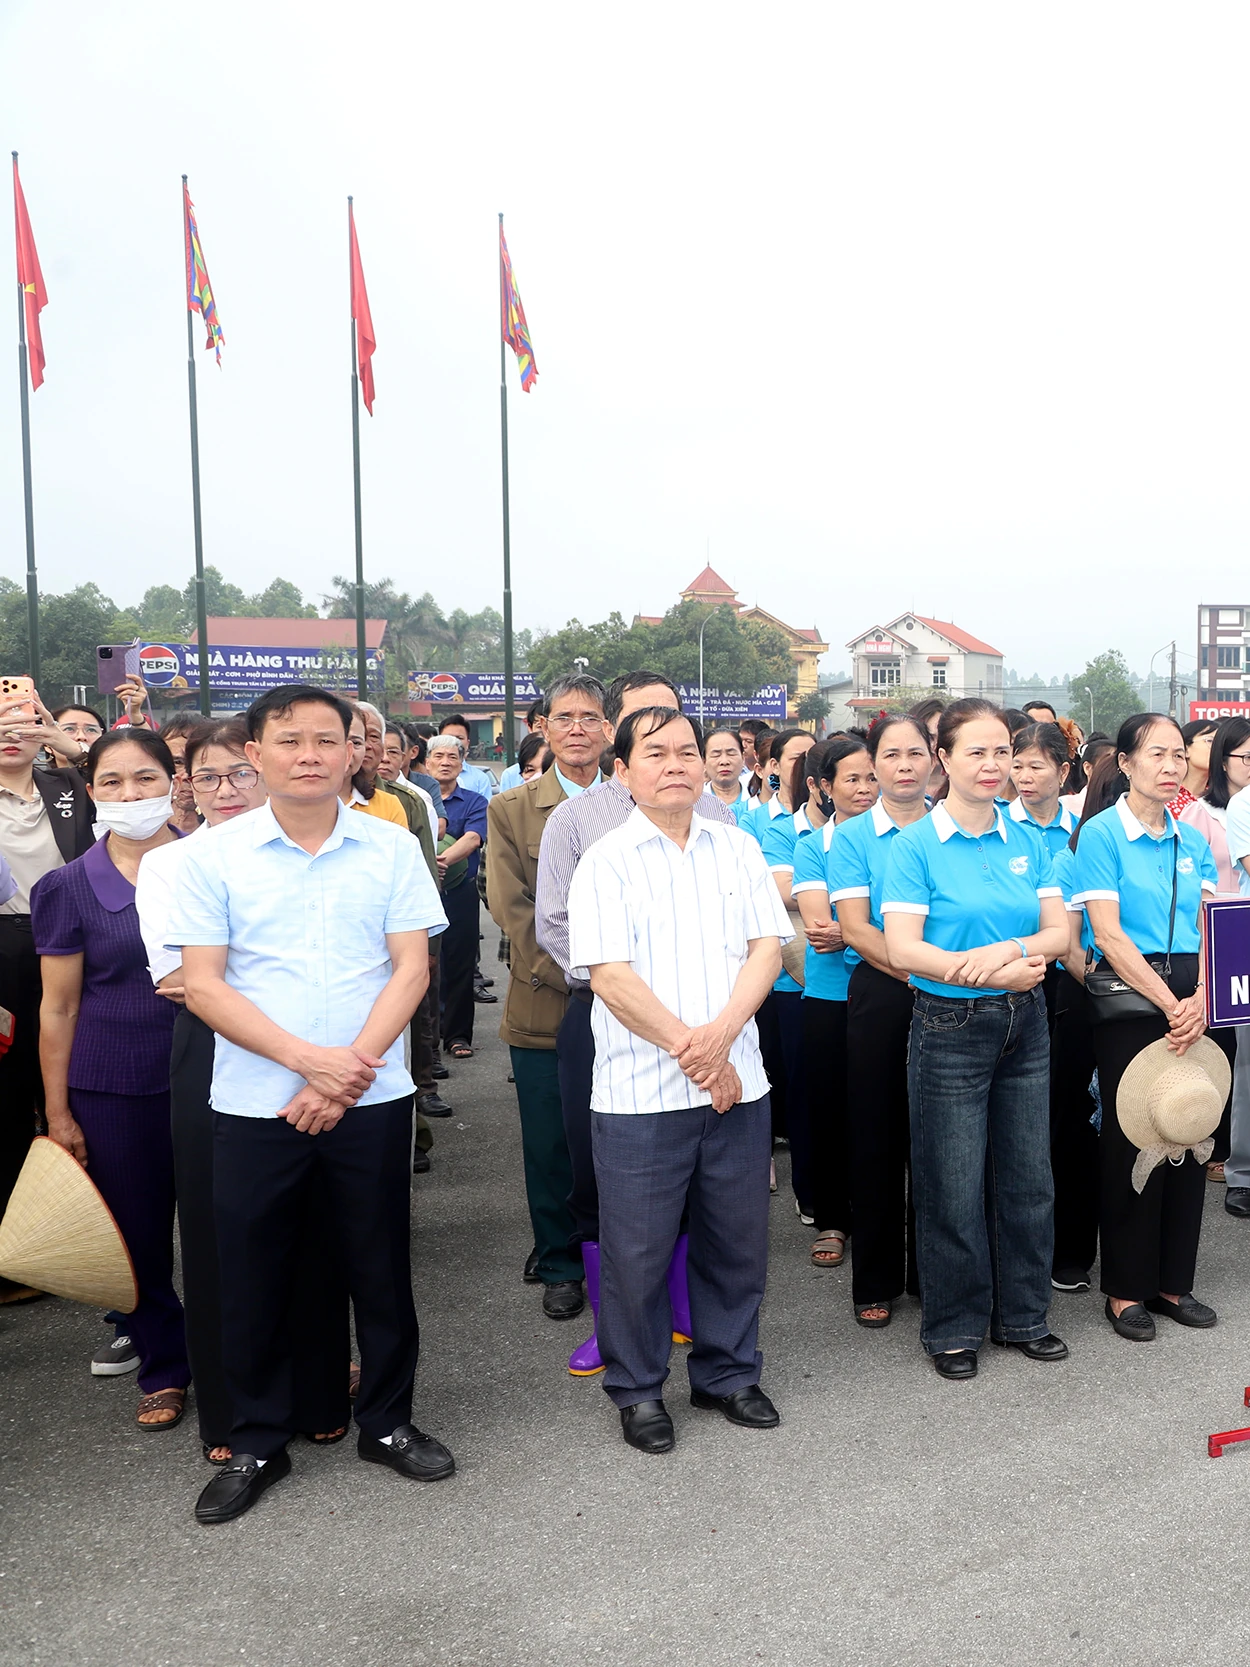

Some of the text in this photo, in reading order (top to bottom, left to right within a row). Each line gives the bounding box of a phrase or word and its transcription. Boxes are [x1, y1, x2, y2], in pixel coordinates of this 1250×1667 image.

[140, 660, 177, 670] PEPSI
[230, 651, 283, 669] HÀNG
[286, 655, 322, 669] THU
[431, 683, 457, 691] PEPSI
[515, 682, 537, 695] BÀ
